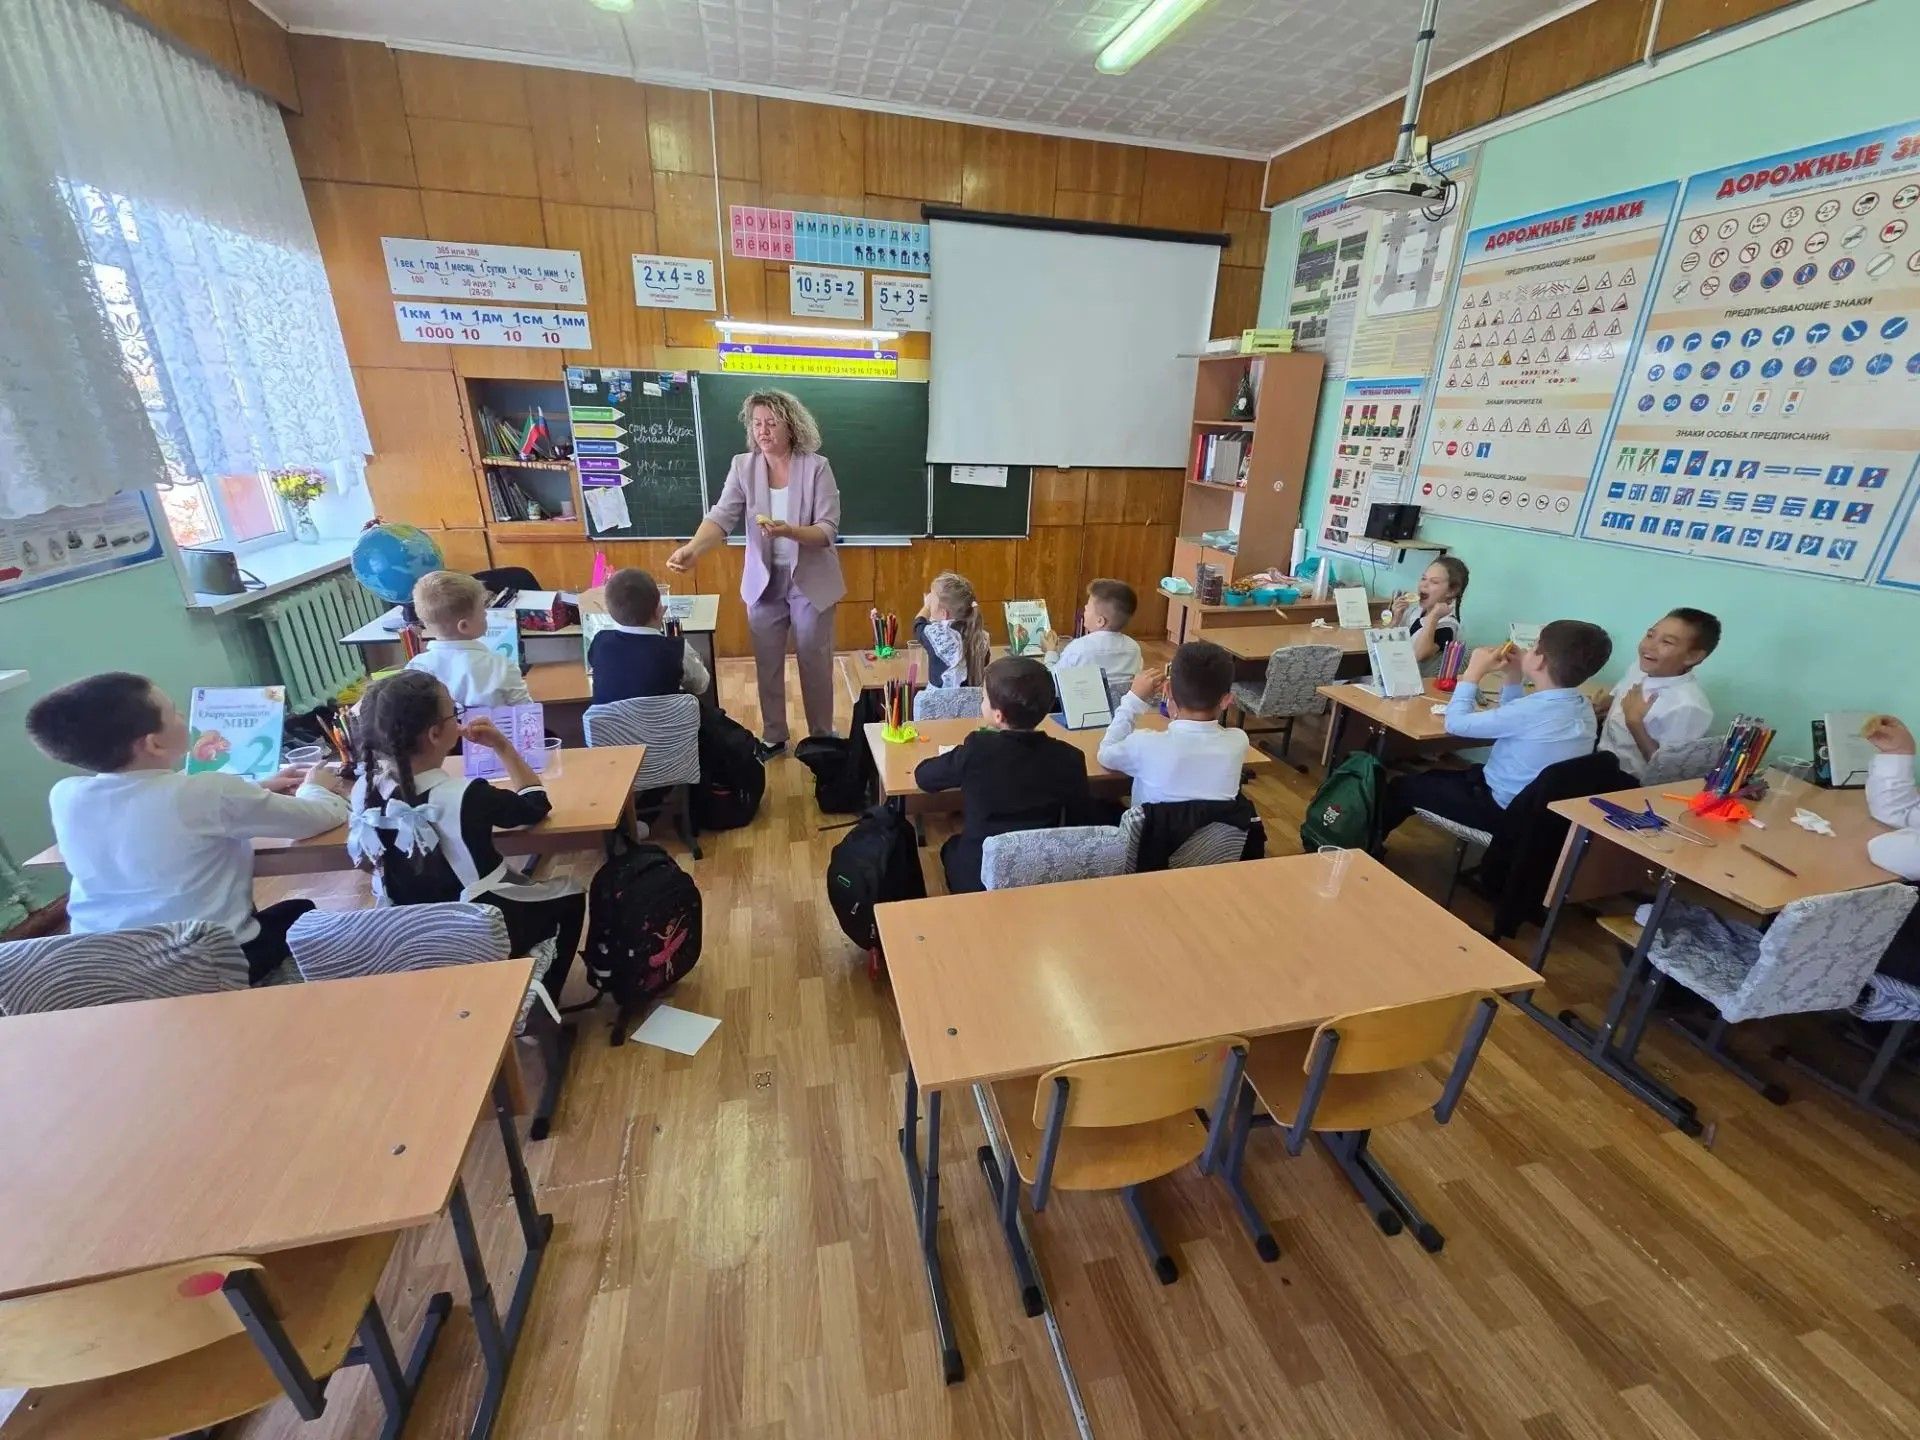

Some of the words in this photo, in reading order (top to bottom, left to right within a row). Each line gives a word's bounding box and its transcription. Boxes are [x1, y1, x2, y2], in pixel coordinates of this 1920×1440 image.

[1715, 143, 1885, 200] ДОРОЖНЫЕ
[1484, 214, 1579, 252] ДОРОЖНЫЕ
[1582, 199, 1646, 229] ЗНАКИ
[450, 247, 465, 255] или
[1572, 253, 1596, 265] ЗНАКИ
[411, 275, 425, 284] 100
[440, 277, 449, 286] 12
[644, 265, 653, 281] 2
[670, 267, 680, 283] 4
[697, 269, 705, 285] 8
[534, 283, 544, 291] 60
[796, 276, 812, 292] 10
[824, 279, 831, 294] 5
[847, 281, 854, 296] 2
[880, 287, 889, 304] 5
[906, 289, 915, 306] 3
[1724, 300, 1832, 319] ПРЕДПИСЫВАЮЩИЕ
[1833, 296, 1873, 309] ЗНАКИ
[416, 326, 454, 339] 1000
[461, 328, 480, 340] 10
[503, 331, 522, 342] 10
[542, 332, 560, 344] 10
[1675, 429, 1705, 437] ЗНАКИ
[1706, 430, 1749, 439] ОСОБЫХ
[1750, 430, 1831, 441] ПРЕДПИСАНИЙ
[246, 735, 275, 774] 2
